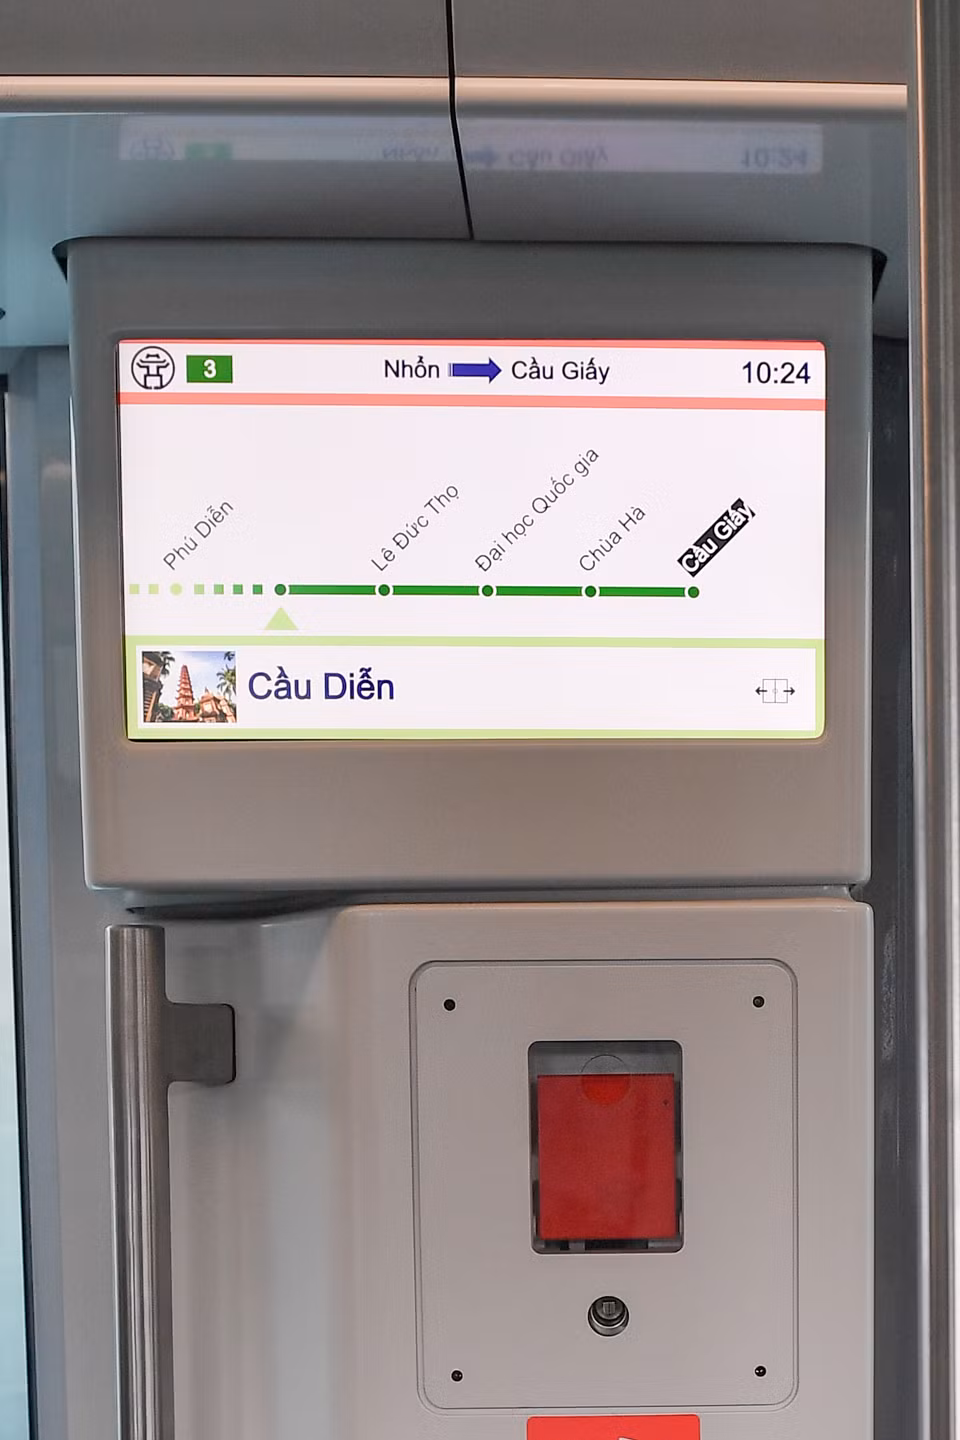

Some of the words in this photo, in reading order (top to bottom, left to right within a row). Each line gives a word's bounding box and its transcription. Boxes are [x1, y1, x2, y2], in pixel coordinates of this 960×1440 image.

[203, 359, 217, 379] 3
[384, 356, 440, 379] Nhổn
[511, 357, 554, 380] Cầu
[561, 357, 610, 385] Giấy
[742, 361, 811, 384] 10:24
[163, 536, 199, 571] Phú
[194, 500, 234, 539] Diễn
[371, 546, 396, 572] Lê
[392, 514, 429, 551] Đức
[424, 484, 460, 517] Thọ
[475, 540, 506, 572] Đại
[502, 513, 535, 546] học
[531, 473, 575, 514] Quốc
[574, 449, 599, 477] gia
[579, 530, 622, 571] Chùa
[618, 505, 646, 532] Hà
[248, 666, 311, 700] Cầu
[324, 667, 395, 700] Diễn
